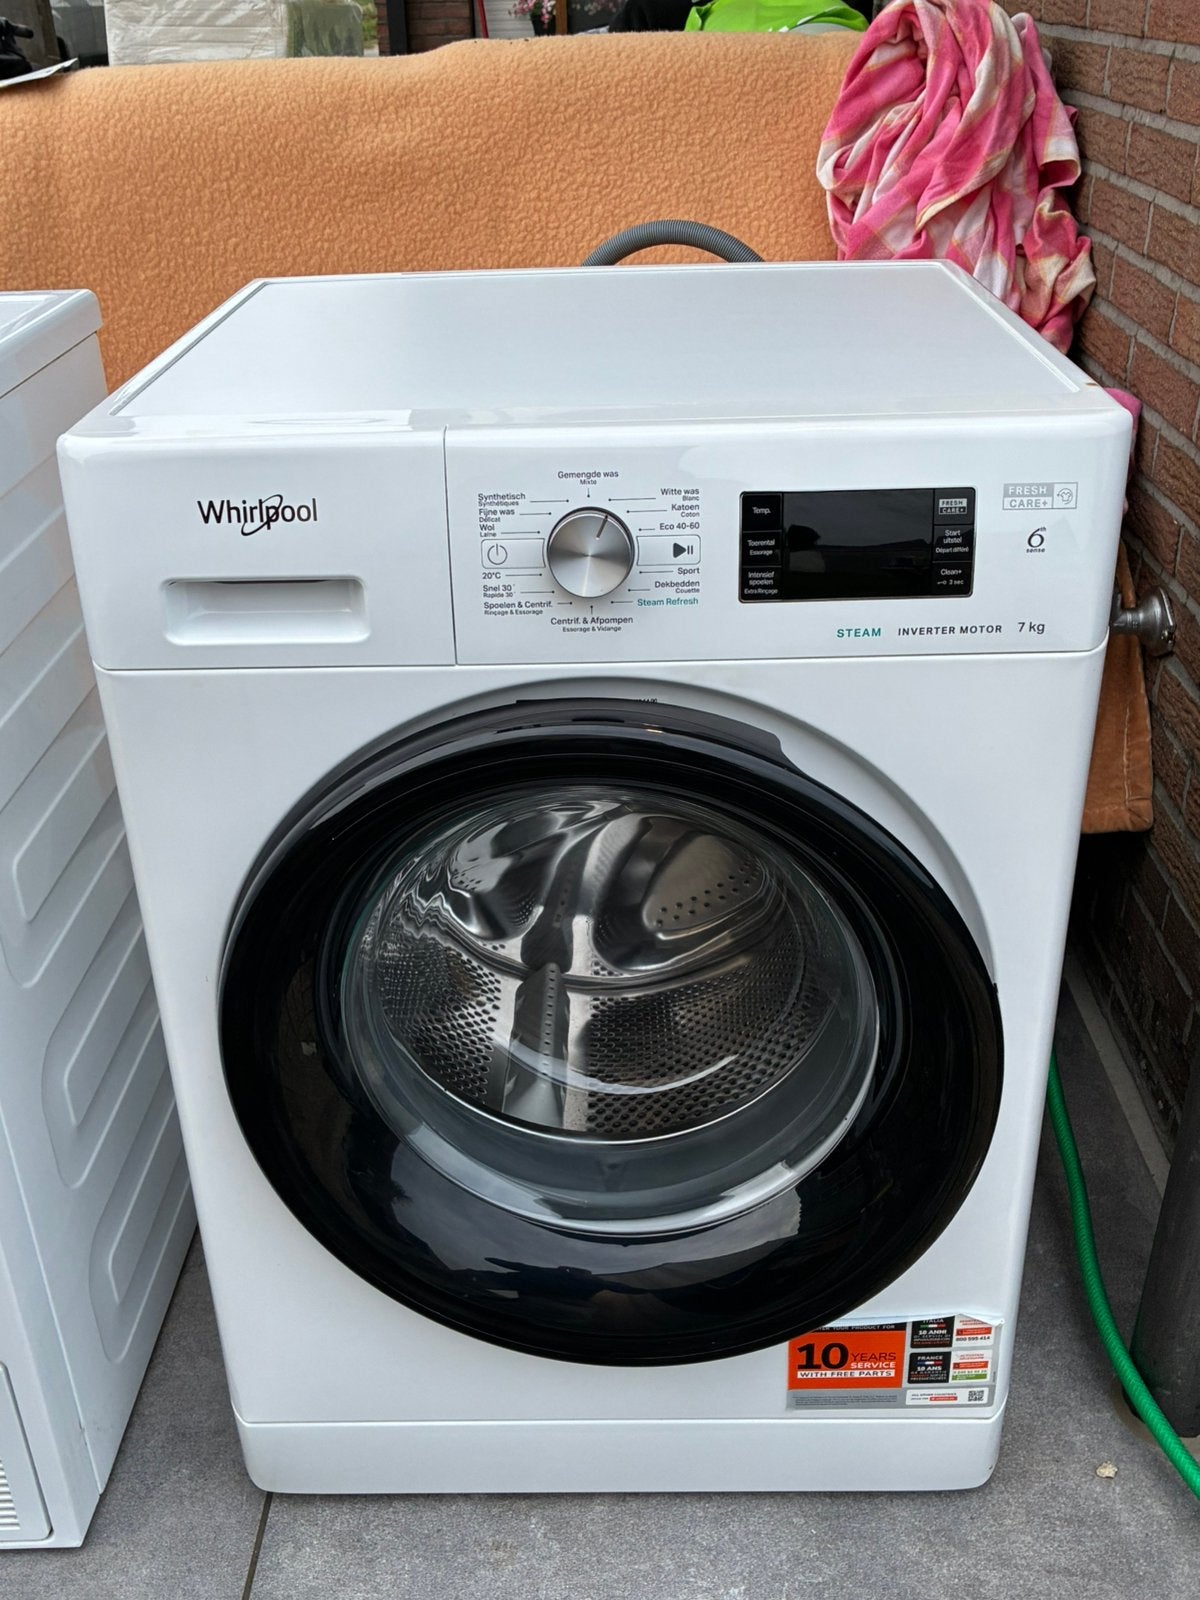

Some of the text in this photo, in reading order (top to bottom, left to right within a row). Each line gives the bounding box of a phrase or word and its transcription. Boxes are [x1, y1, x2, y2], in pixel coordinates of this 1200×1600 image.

[557, 470, 619, 479] Gemengde was
[660, 488, 682, 496] Witte
[1008, 485, 1047, 495] FRESH
[478, 492, 526, 502] Synthetisch
[671, 503, 700, 511] Katoen
[1009, 498, 1048, 508] CARE+
[197, 494, 318, 536] Whirlpool
[479, 508, 498, 517] Fijne
[752, 506, 771, 515] Temp.
[479, 523, 495, 531] Wol
[659, 521, 700, 530] Eco 40-60
[747, 538, 776, 547] Toerental
[482, 571, 502, 580] 20°C
[677, 567, 700, 575] Sport
[748, 571, 775, 579] Intensief
[654, 580, 700, 588] Dekbedden
[748, 578, 774, 586] spoelen
[482, 584, 500, 592] Snel
[483, 601, 516, 610] Spoelen
[524, 600, 553, 608] Centrif.
[637, 597, 699, 607] Steam Refresh
[550, 617, 581, 625] Centrif.
[590, 616, 634, 625] Afpompen
[898, 625, 1003, 636] INVERTER MOTOR
[1017, 621, 1046, 634] 7 kg
[836, 628, 882, 638] STEAM
[797, 1342, 849, 1370] 10
[850, 1352, 897, 1362] YEARS
[850, 1361, 896, 1369] SERVICE
